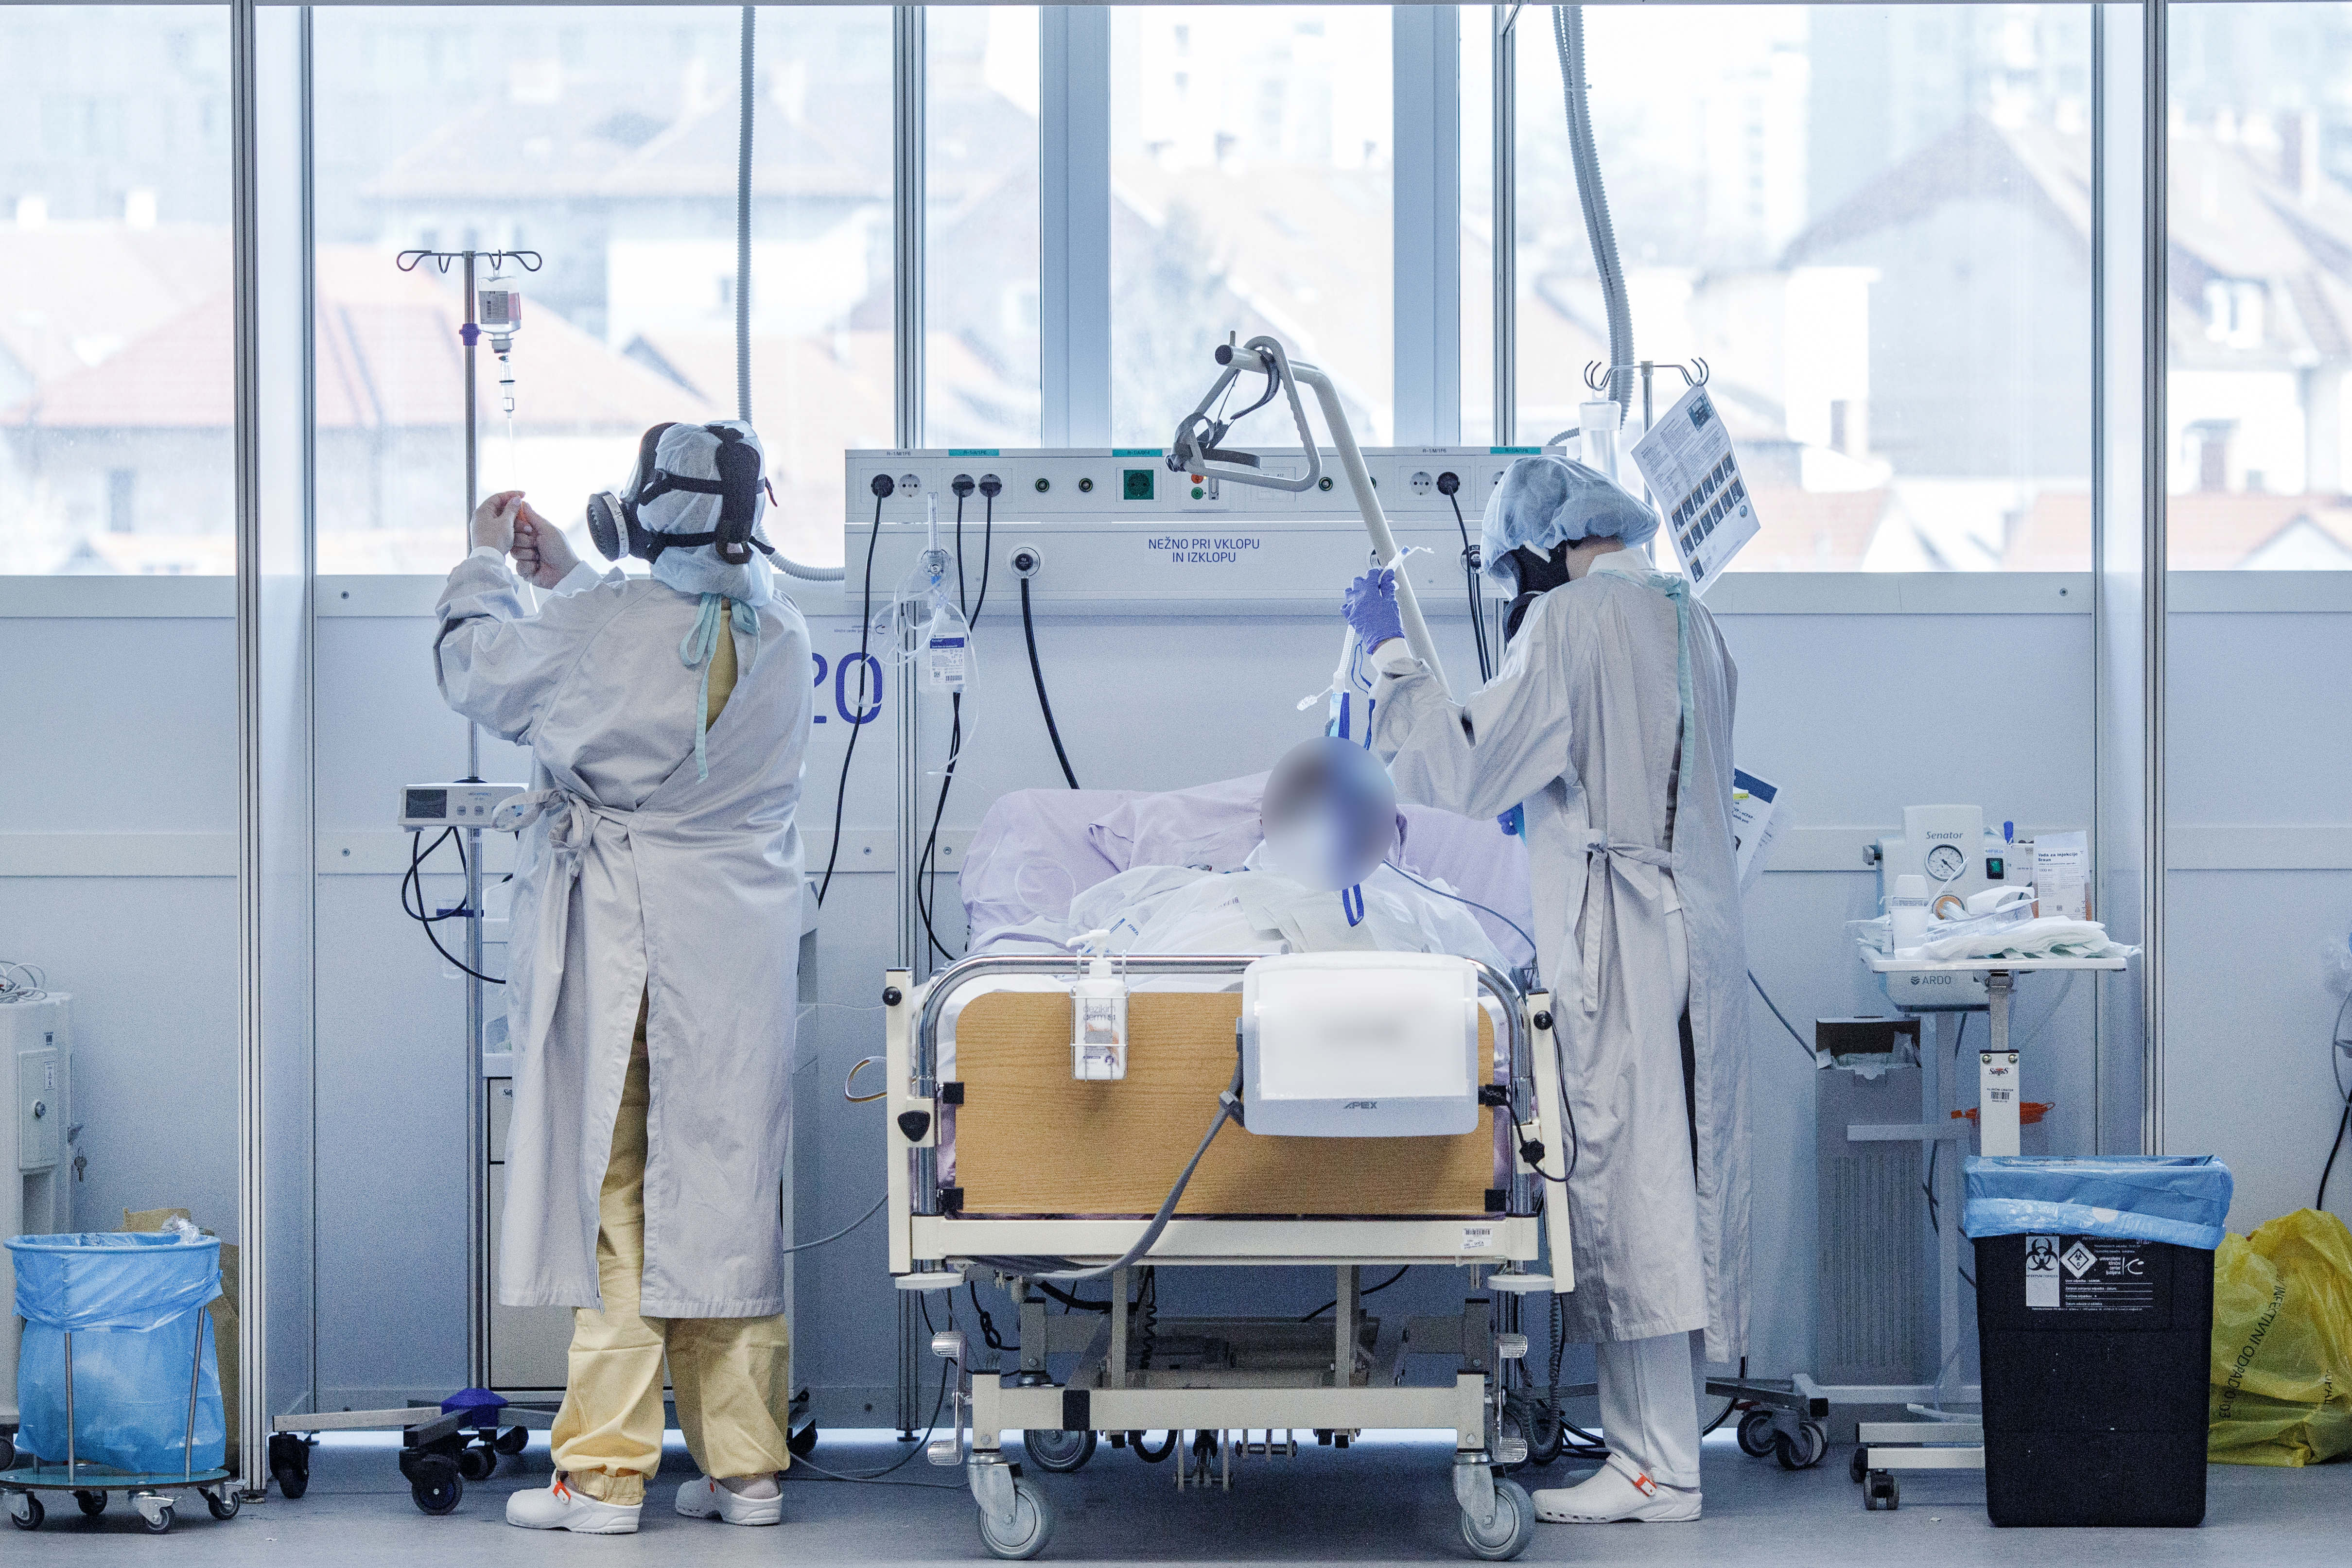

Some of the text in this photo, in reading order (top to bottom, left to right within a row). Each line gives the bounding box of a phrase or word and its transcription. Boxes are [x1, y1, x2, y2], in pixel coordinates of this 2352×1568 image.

[1149, 536, 1260, 549] NEŽNO PRI VKLOPU
[1172, 552, 1236, 562] IN IZKLOPU
[1926, 831, 1964, 839] Senator
[1922, 975, 1951, 985] ARDO
[2228, 1345, 2255, 1389] ODPAD
